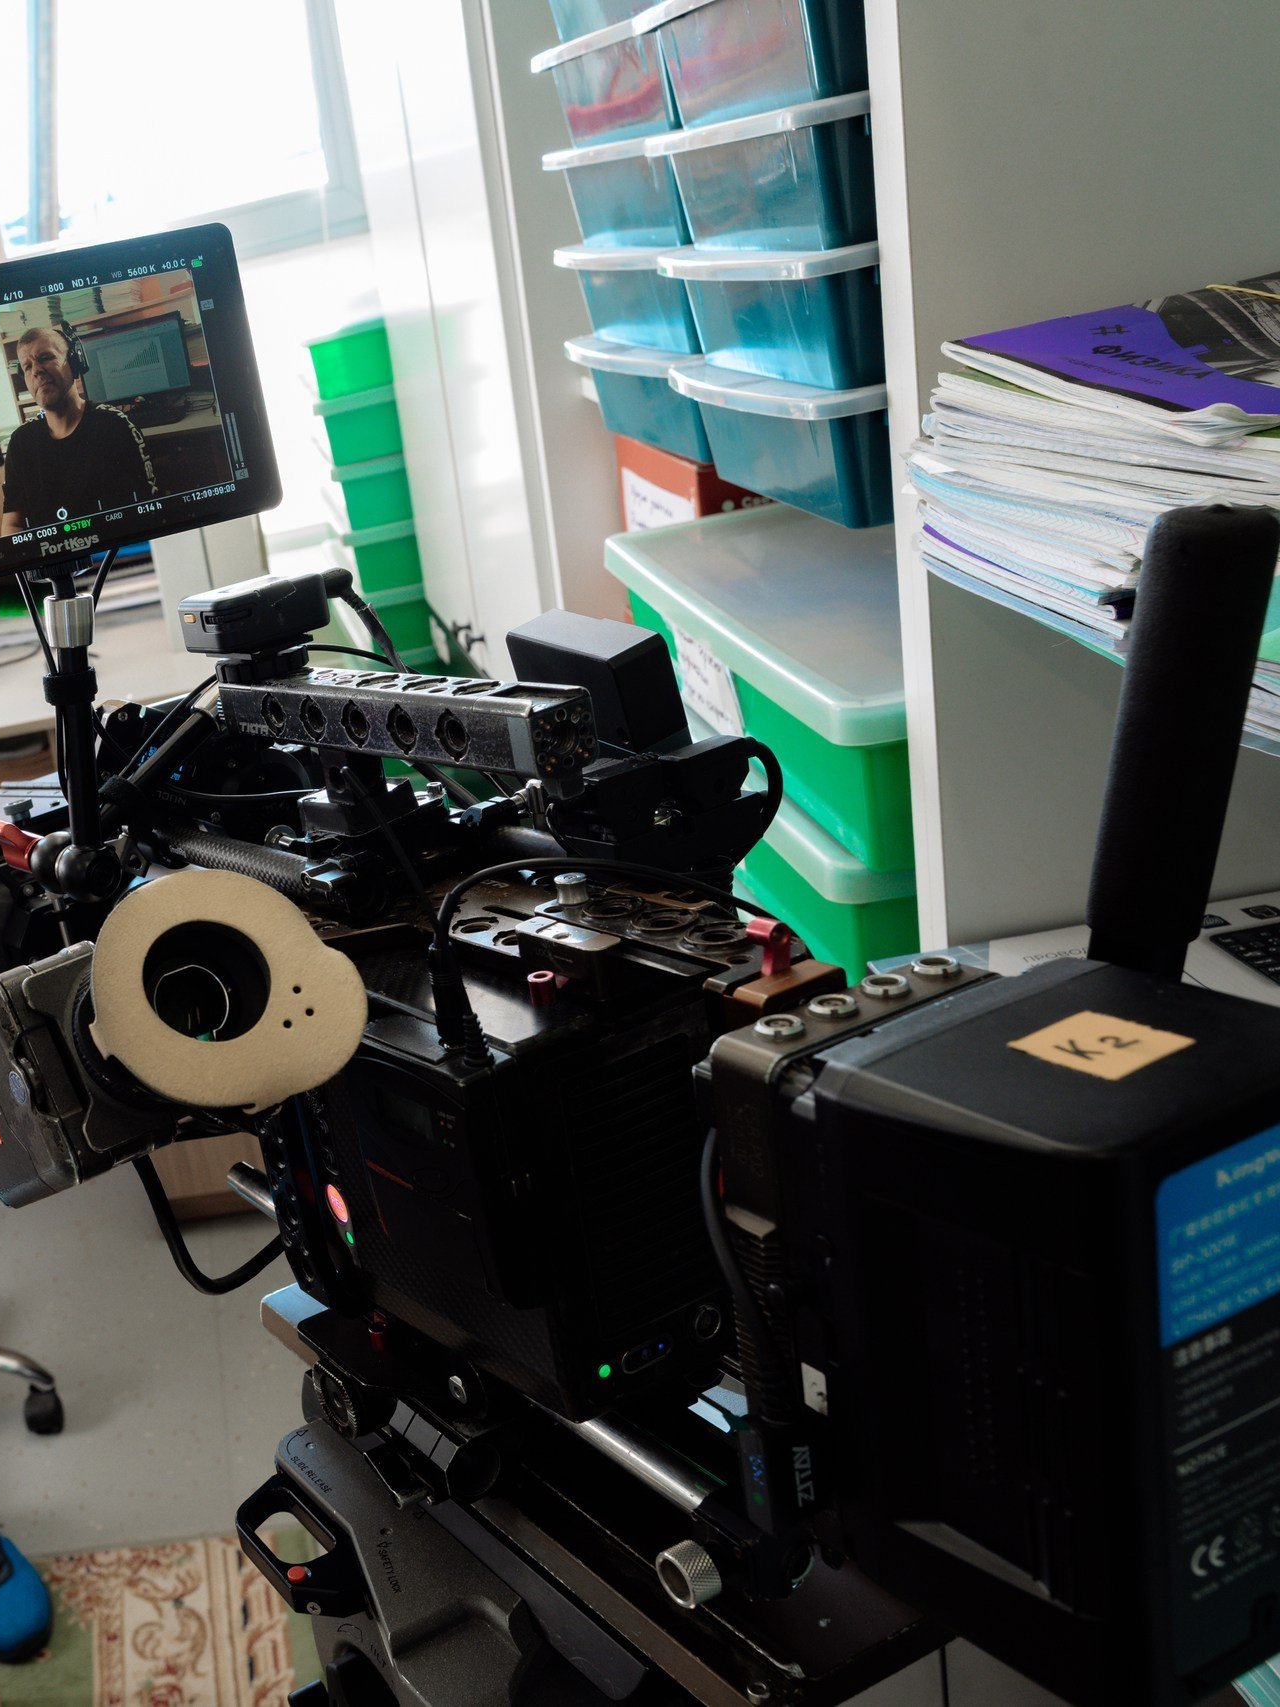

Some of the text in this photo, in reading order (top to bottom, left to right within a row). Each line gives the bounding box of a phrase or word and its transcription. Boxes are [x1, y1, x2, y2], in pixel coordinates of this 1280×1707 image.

[111, 264, 156, 279] WB 5600 K
[162, 258, 186, 270] +0.0 C
[40, 282, 64, 293] EI 800
[72, 276, 98, 289] ND 1.2
[3, 290, 24, 302] 4/10
[1091, 345, 1215, 379] ФИЗИКА
[182, 495, 191, 503] TC
[105, 501, 162, 522] CARD 0:14 h
[12, 519, 92, 545] B049 C003 STBY
[40, 534, 100, 557] PortKeys
[290, 1455, 332, 1495] SLIDE RELEASE
[377, 1549, 402, 1595] SAFETY LOCK
